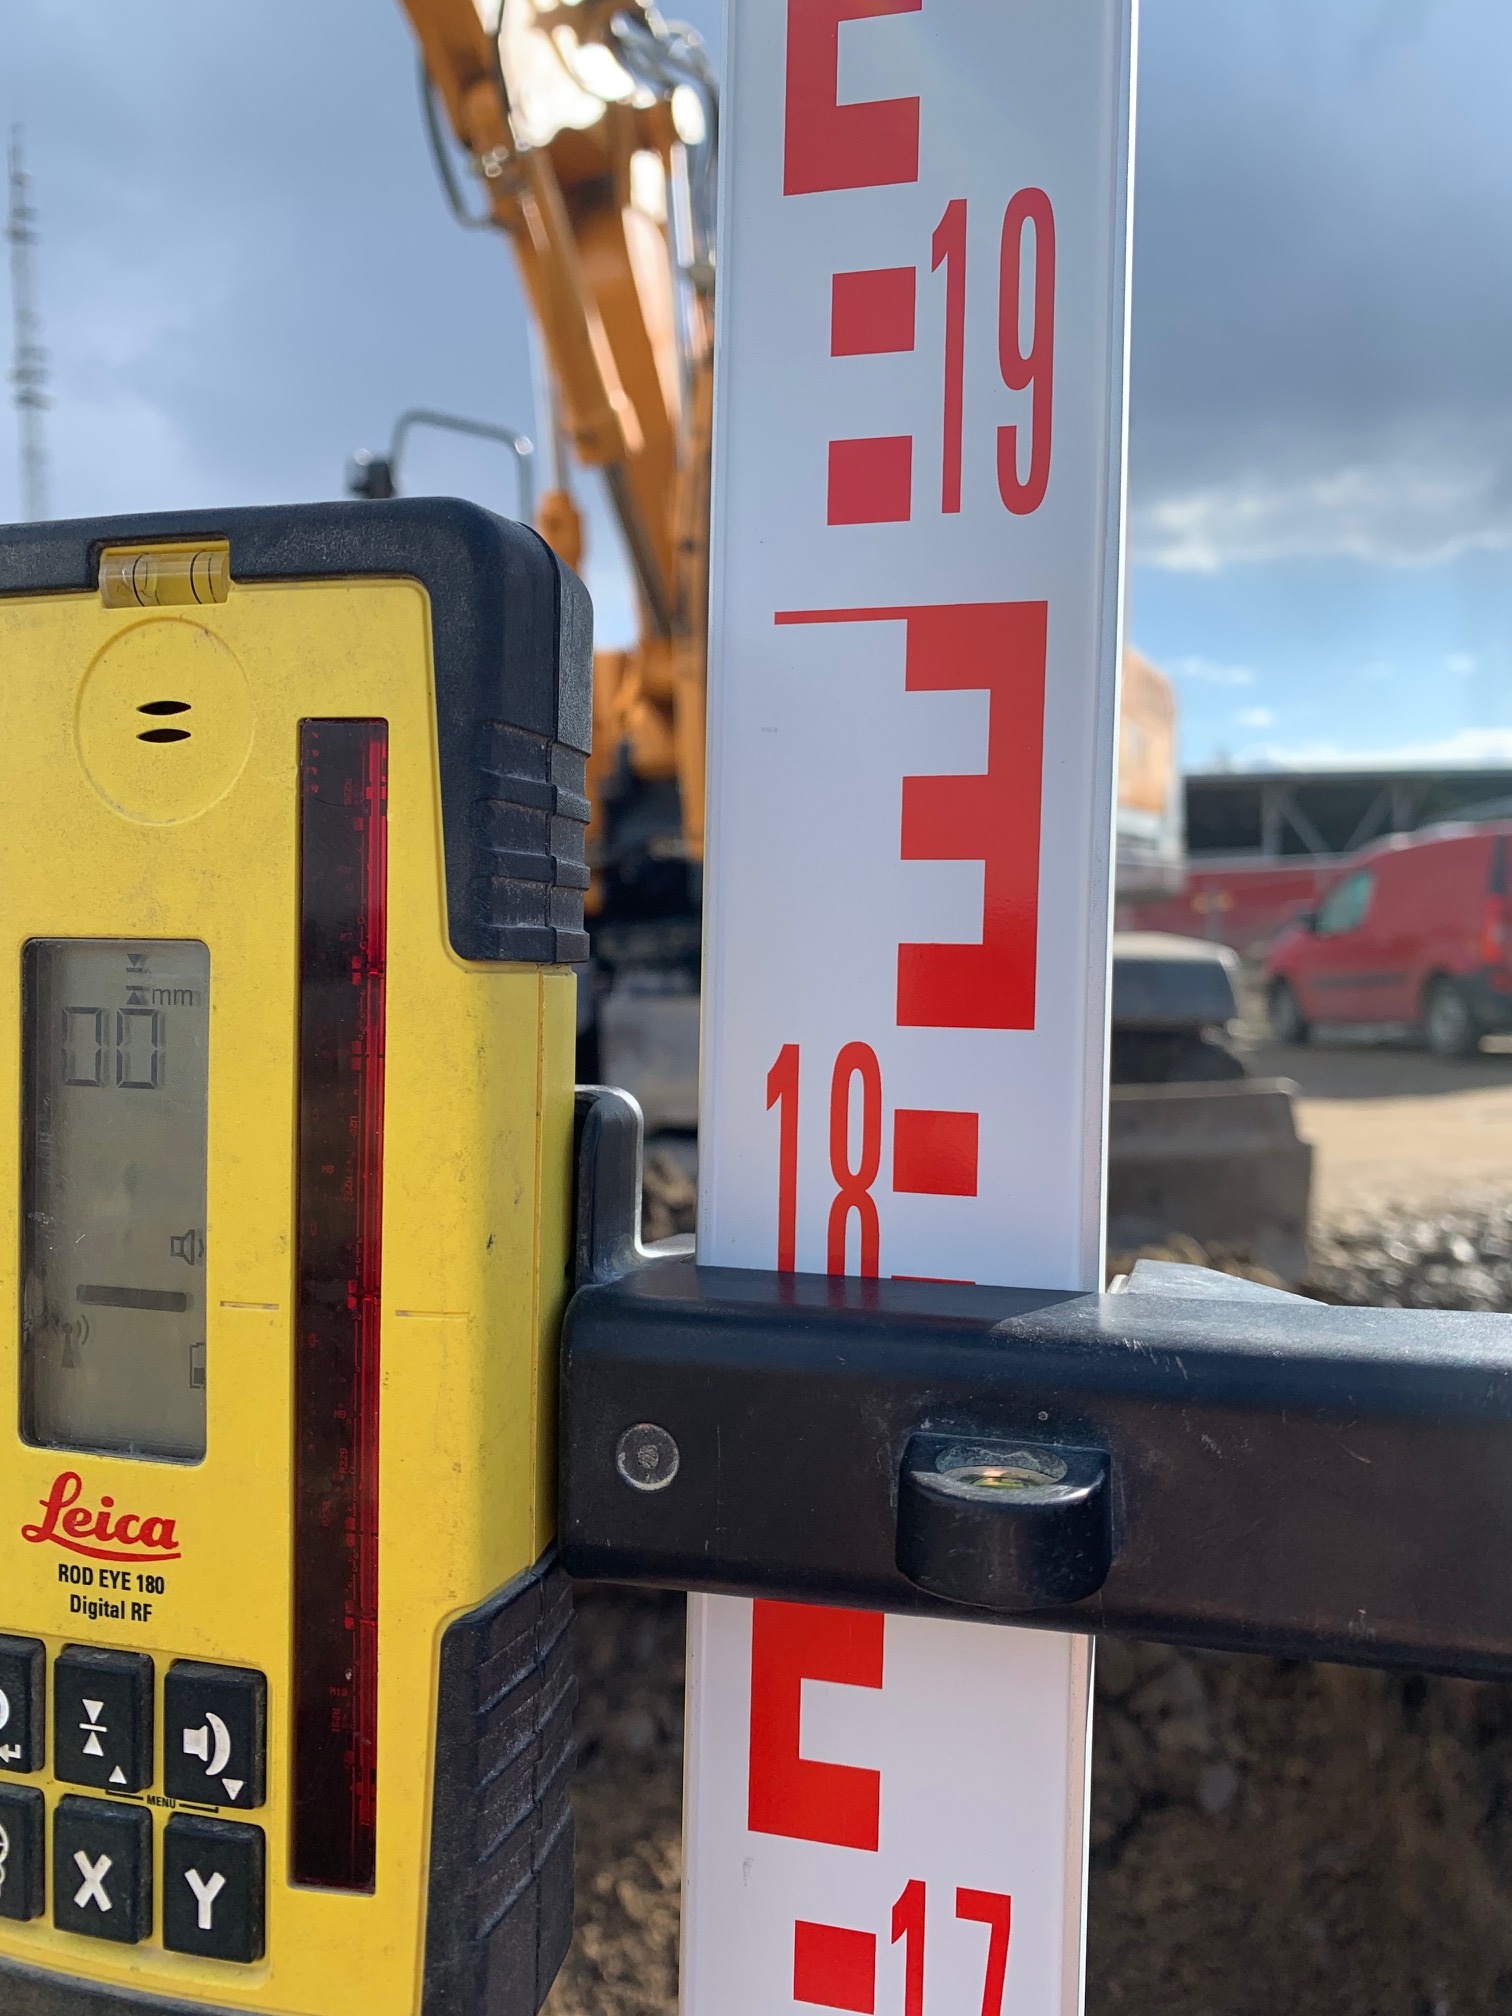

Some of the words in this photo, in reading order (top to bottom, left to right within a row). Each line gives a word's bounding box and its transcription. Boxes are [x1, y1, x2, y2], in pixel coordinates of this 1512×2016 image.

[930, 187, 1055, 515] 19
[152, 988, 193, 1006] mm
[766, 1041, 882, 1279] 18
[21, 1471, 181, 1562] Leica
[58, 1563, 93, 1586] ROD
[99, 1568, 131, 1591] EYE
[136, 1574, 165, 1595] 180
[70, 1594, 125, 1620] Digital
[131, 1602, 153, 1622] RF
[146, 1795, 176, 1809] MENU
[73, 1850, 112, 1912] X
[184, 1868, 226, 1930] Y
